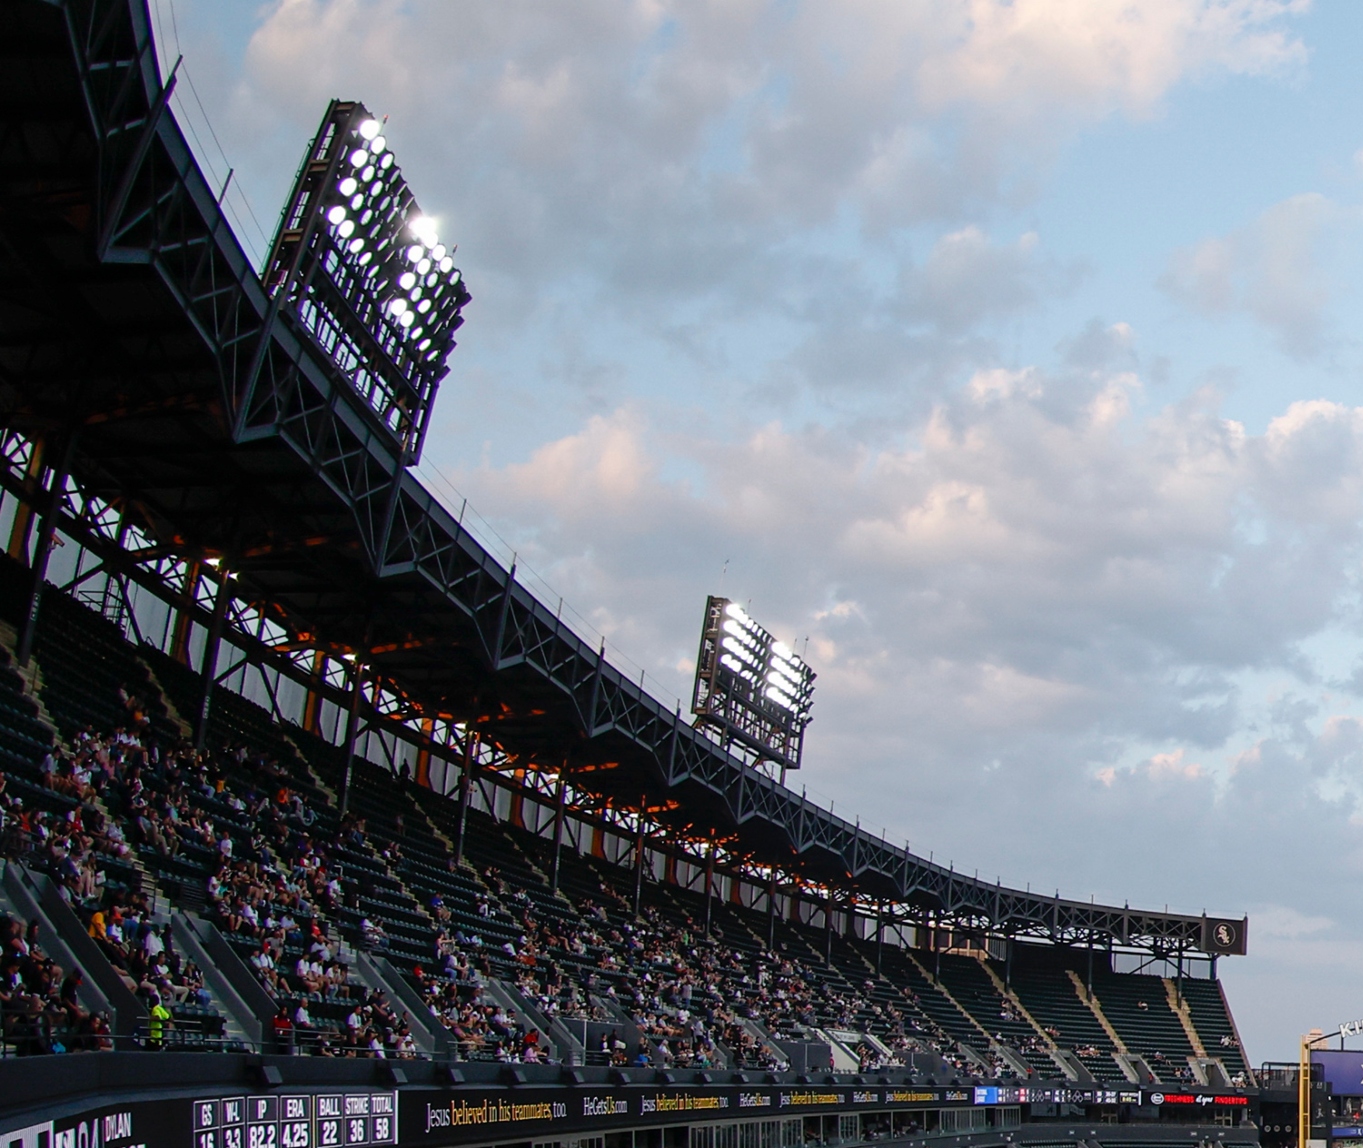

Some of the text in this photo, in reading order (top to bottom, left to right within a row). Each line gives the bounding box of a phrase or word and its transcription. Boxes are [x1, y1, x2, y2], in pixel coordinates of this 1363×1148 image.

[201, 1096, 393, 1126] GS W-L IP ERA BALL STRIKE TOTAL
[425, 1102, 450, 1133] Jesus
[450, 1099, 488, 1126] believed
[489, 1101, 498, 1122] in
[498, 1098, 511, 1122] his
[511, 1100, 553, 1121] teammates,
[583, 1096, 628, 1117] HeGetsUs.com
[641, 1093, 678, 1115] Jesus believed
[104, 1112, 132, 1142] DYLAN
[282, 1122, 309, 1148] 4.25
[322, 1121, 338, 1145] 22
[349, 1119, 364, 1142] 36
[375, 1117, 390, 1140] 58
